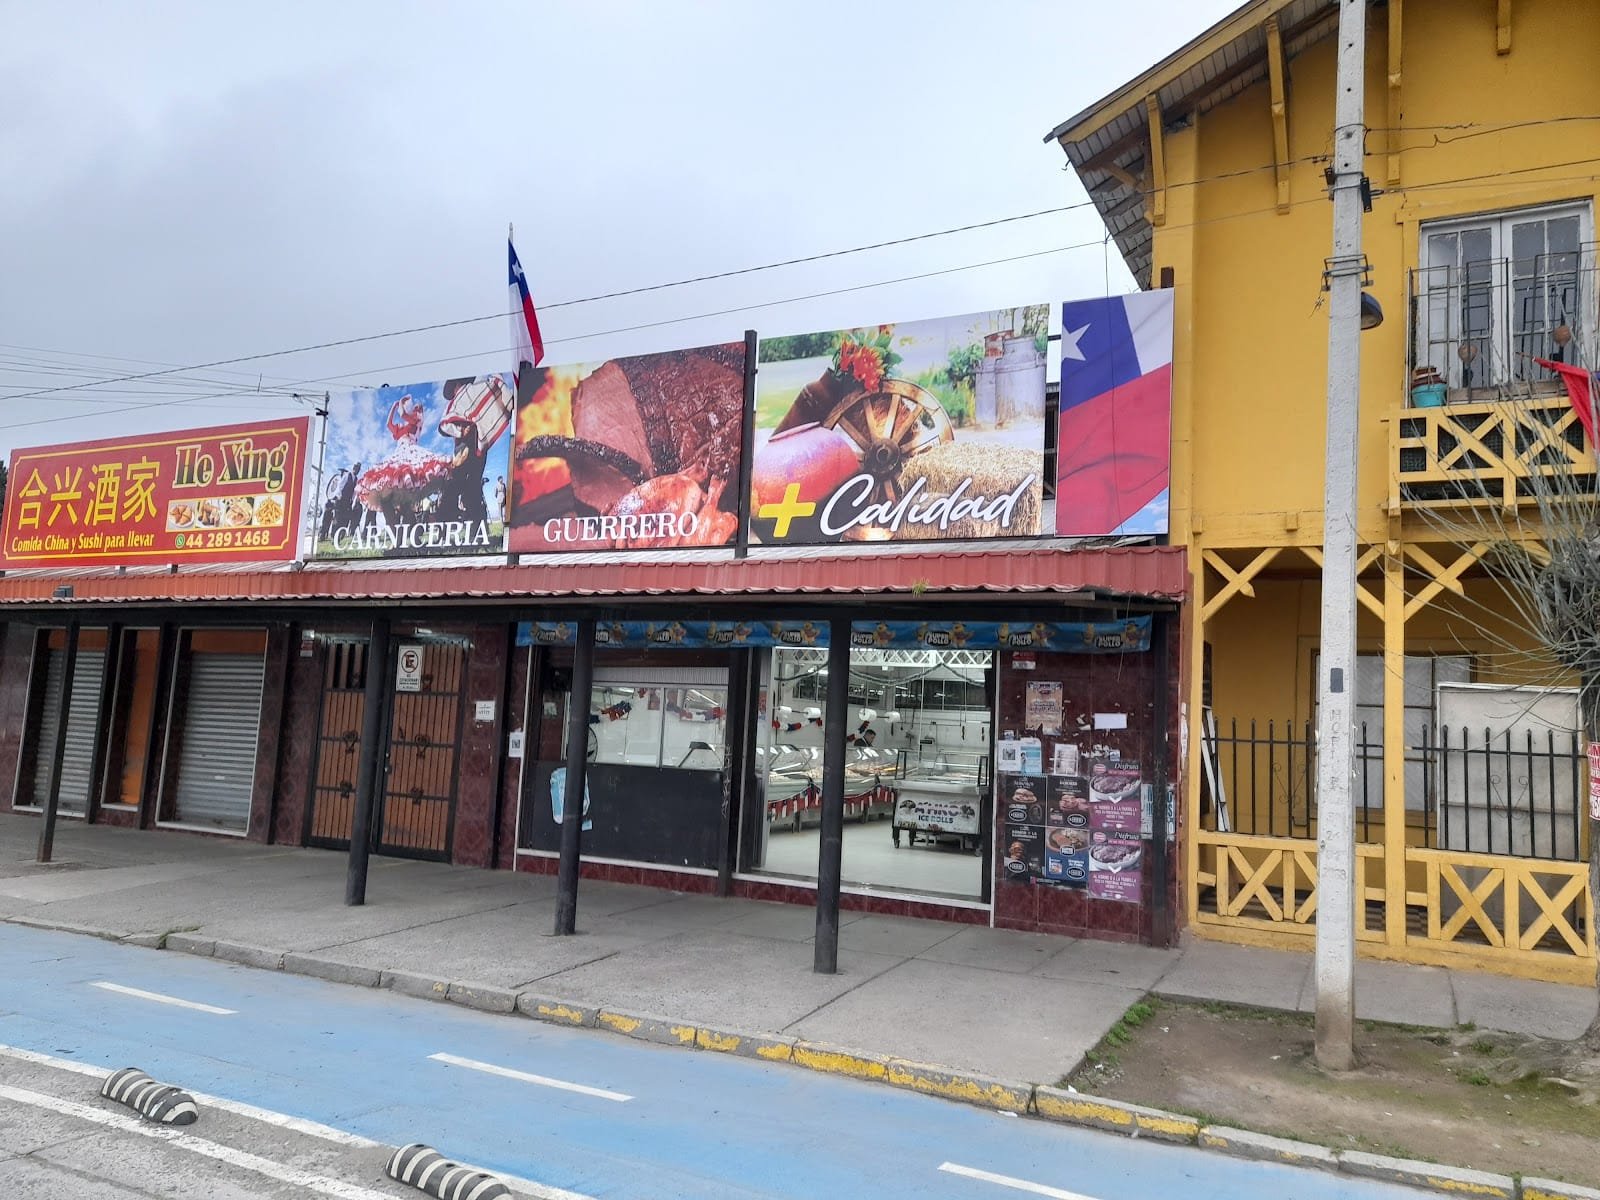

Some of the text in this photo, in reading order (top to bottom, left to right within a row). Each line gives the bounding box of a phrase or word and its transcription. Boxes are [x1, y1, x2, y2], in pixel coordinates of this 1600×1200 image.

[216, 438, 289, 492] Xing
[18, 455, 161, 531] 合兴酒家
[820, 473, 1036, 536] Calidad
[11, 530, 155, 553] Comida China y Sushi para llevar
[186, 529, 270, 548] 44 289 1468
[333, 519, 491, 551] CARNICERIA
[543, 511, 699, 544] GUERRERO
